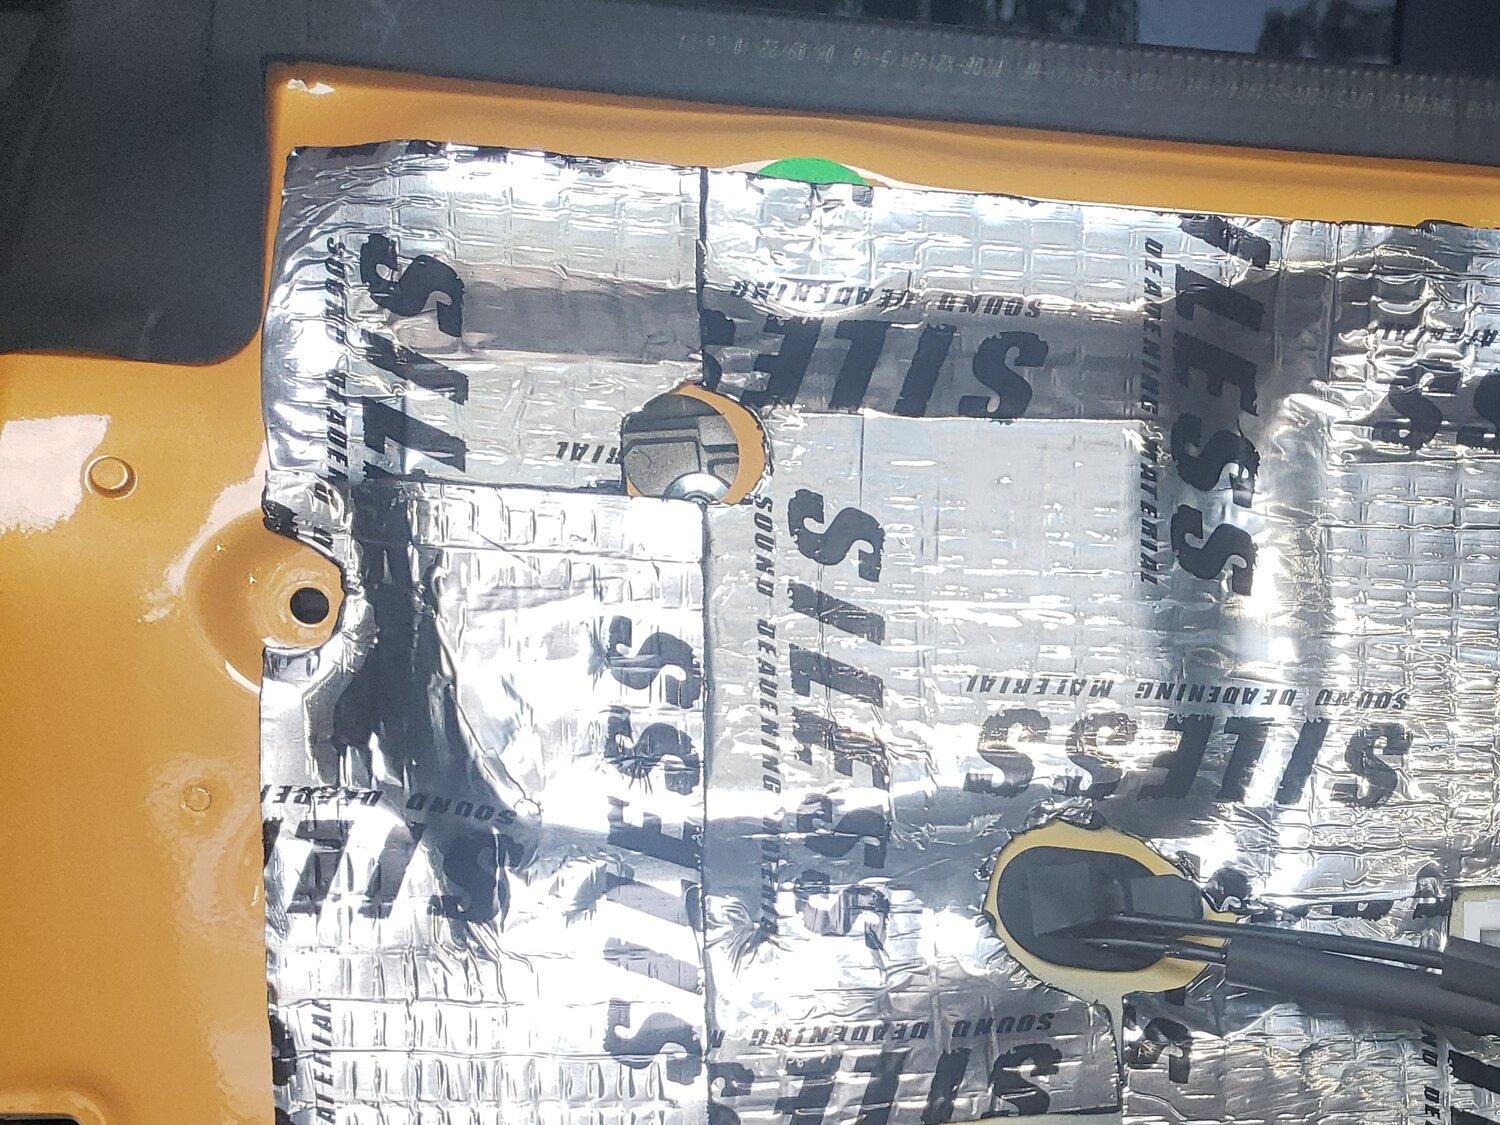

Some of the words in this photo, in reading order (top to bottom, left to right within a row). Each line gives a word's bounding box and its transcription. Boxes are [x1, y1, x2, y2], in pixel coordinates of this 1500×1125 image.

[359, 233, 470, 480] SIL
[939, 296, 1043, 319] SOUND
[1141, 236, 1164, 415] DEADENING
[755, 496, 775, 598] SOUND
[1139, 424, 1163, 585] MATERIAL
[757, 619, 782, 794] DEADENING
[966, 674, 1114, 698] MATERIAL
[1135, 681, 1297, 707] DEADENING
[1315, 688, 1410, 710] SOUND
[964, 707, 1414, 808] SILESS
[407, 794, 518, 826] SOUND
[603, 615, 705, 1085] SILESS
[263, 818, 538, 925] SIL
[750, 1020, 930, 1048] DEADENING
[952, 1011, 1057, 1037] SOUND
